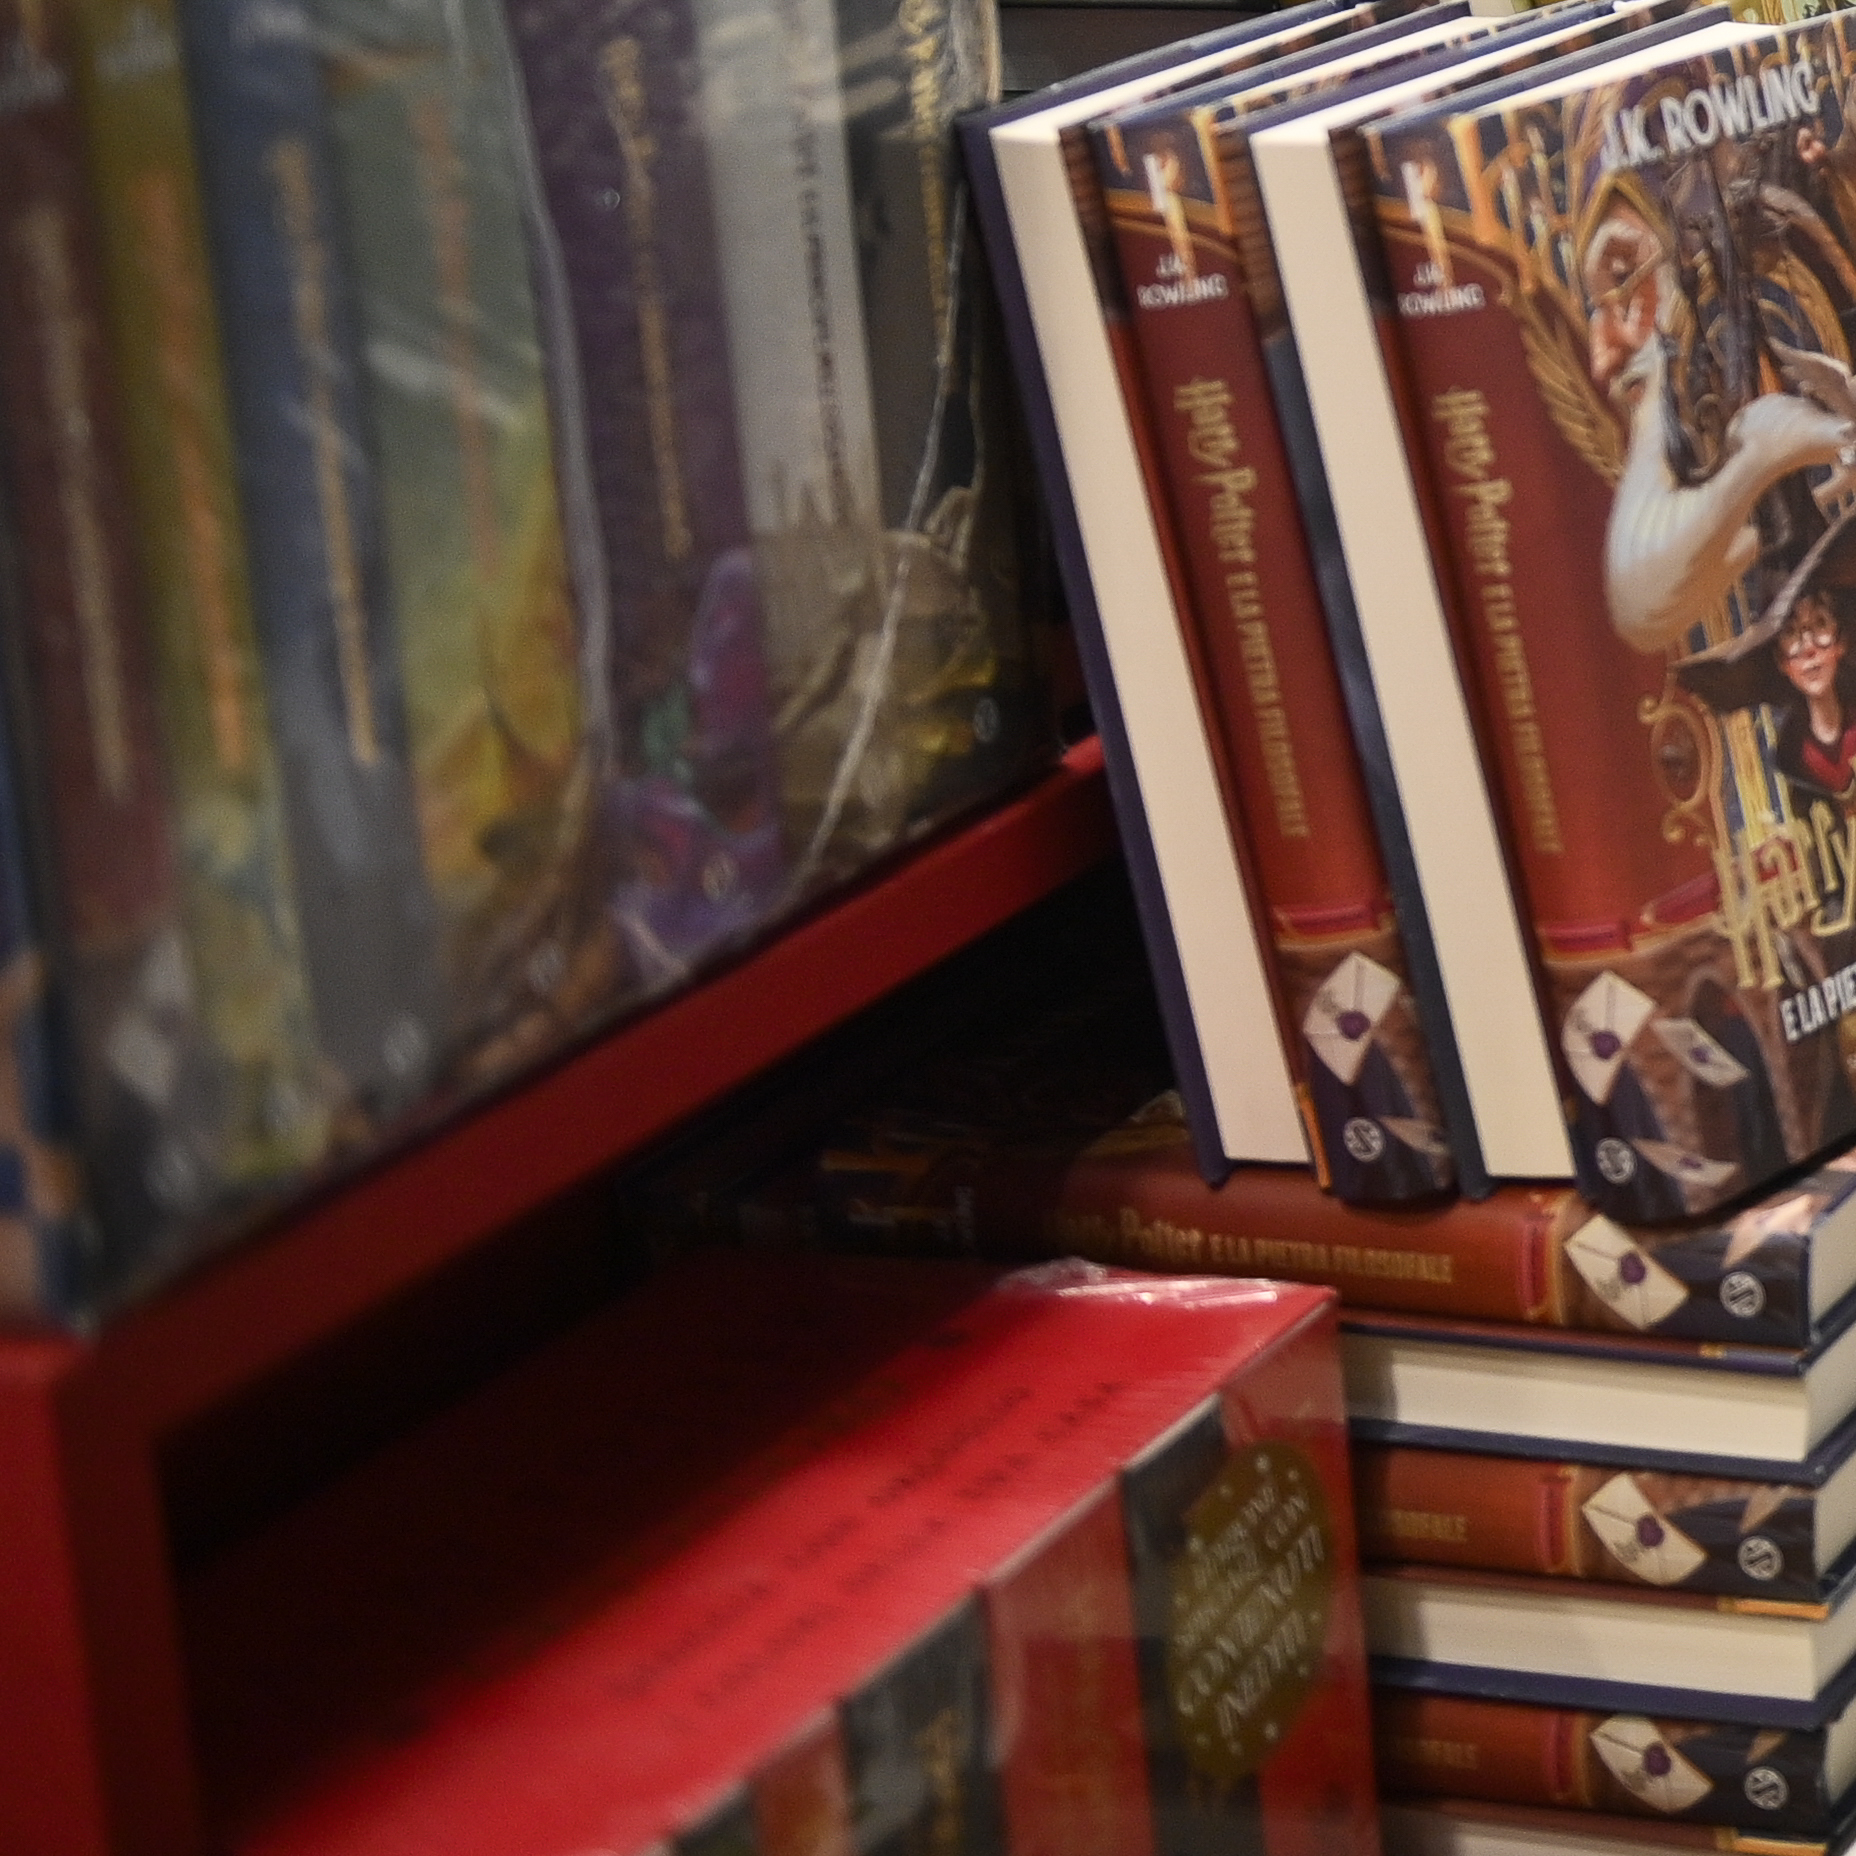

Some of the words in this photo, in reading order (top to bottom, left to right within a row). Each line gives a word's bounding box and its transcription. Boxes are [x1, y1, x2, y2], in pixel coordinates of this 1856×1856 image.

[1601, 105, 1664, 172] J.K.
[1659, 60, 1822, 161] ROWLING
[1136, 274, 1229, 311] ROWLING
[1172, 380, 1243, 469] Harry
[1433, 390, 1495, 481] Harry
[1193, 466, 1260, 565] Potter
[1453, 477, 1515, 579] Potter
[1236, 620, 1282, 703] PIETRA
[1257, 707, 1309, 838] FILOSOFALE
[1779, 998, 1800, 1043] E
[1796, 984, 1827, 1036] LA
[1118, 1207, 1202, 1266] Potter
[1329, 1243, 1454, 1284] FILOSOFALE
